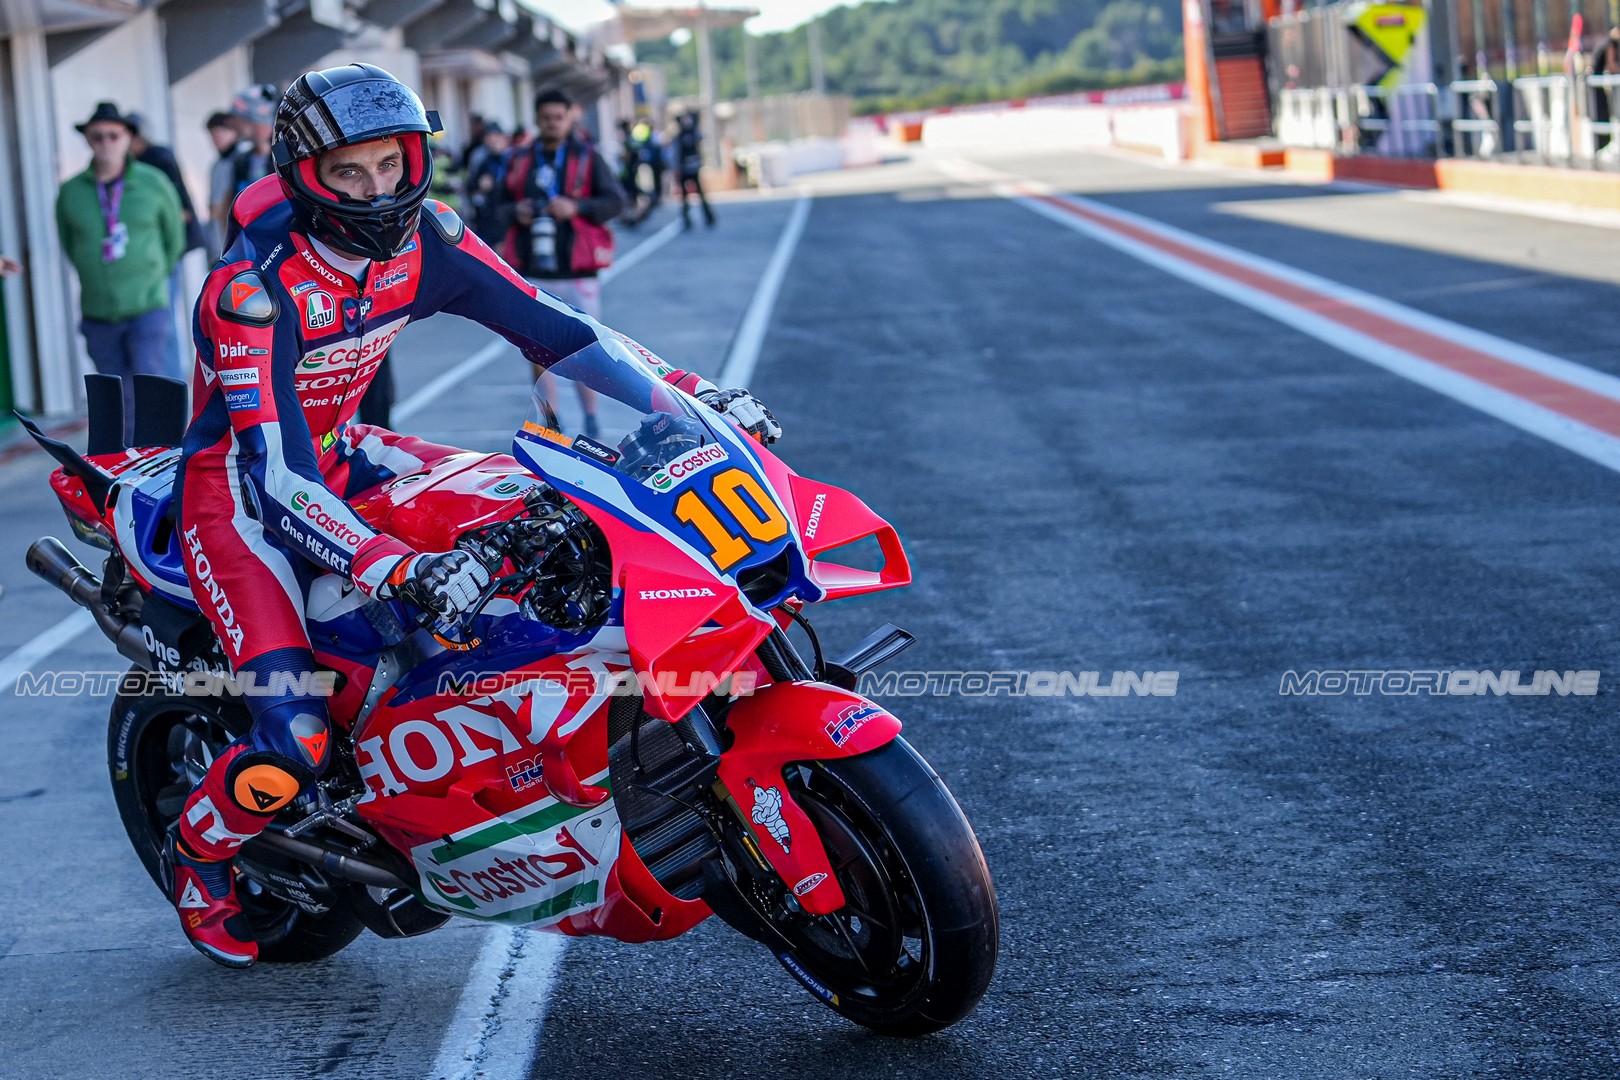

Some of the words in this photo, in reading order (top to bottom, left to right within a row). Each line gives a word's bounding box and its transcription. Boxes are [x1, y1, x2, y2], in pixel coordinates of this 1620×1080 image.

[301, 249, 344, 288] HONDA
[309, 310, 333, 327] agv
[302, 397, 329, 408] One
[524, 420, 573, 448] MARINI
[575, 439, 610, 459] Puig
[668, 444, 726, 479] Castrol
[280, 515, 304, 544] One
[305, 502, 370, 550] Castrol
[672, 466, 791, 576] 10
[804, 492, 827, 539] HONDA
[184, 522, 246, 657] HONDA
[639, 587, 717, 600] HONDA
[141, 624, 181, 667] One
[119, 710, 137, 760] MICHELIN
[354, 651, 633, 805] HONDA
[450, 826, 599, 902] Castrol
[784, 957, 826, 994] MICHELIN
